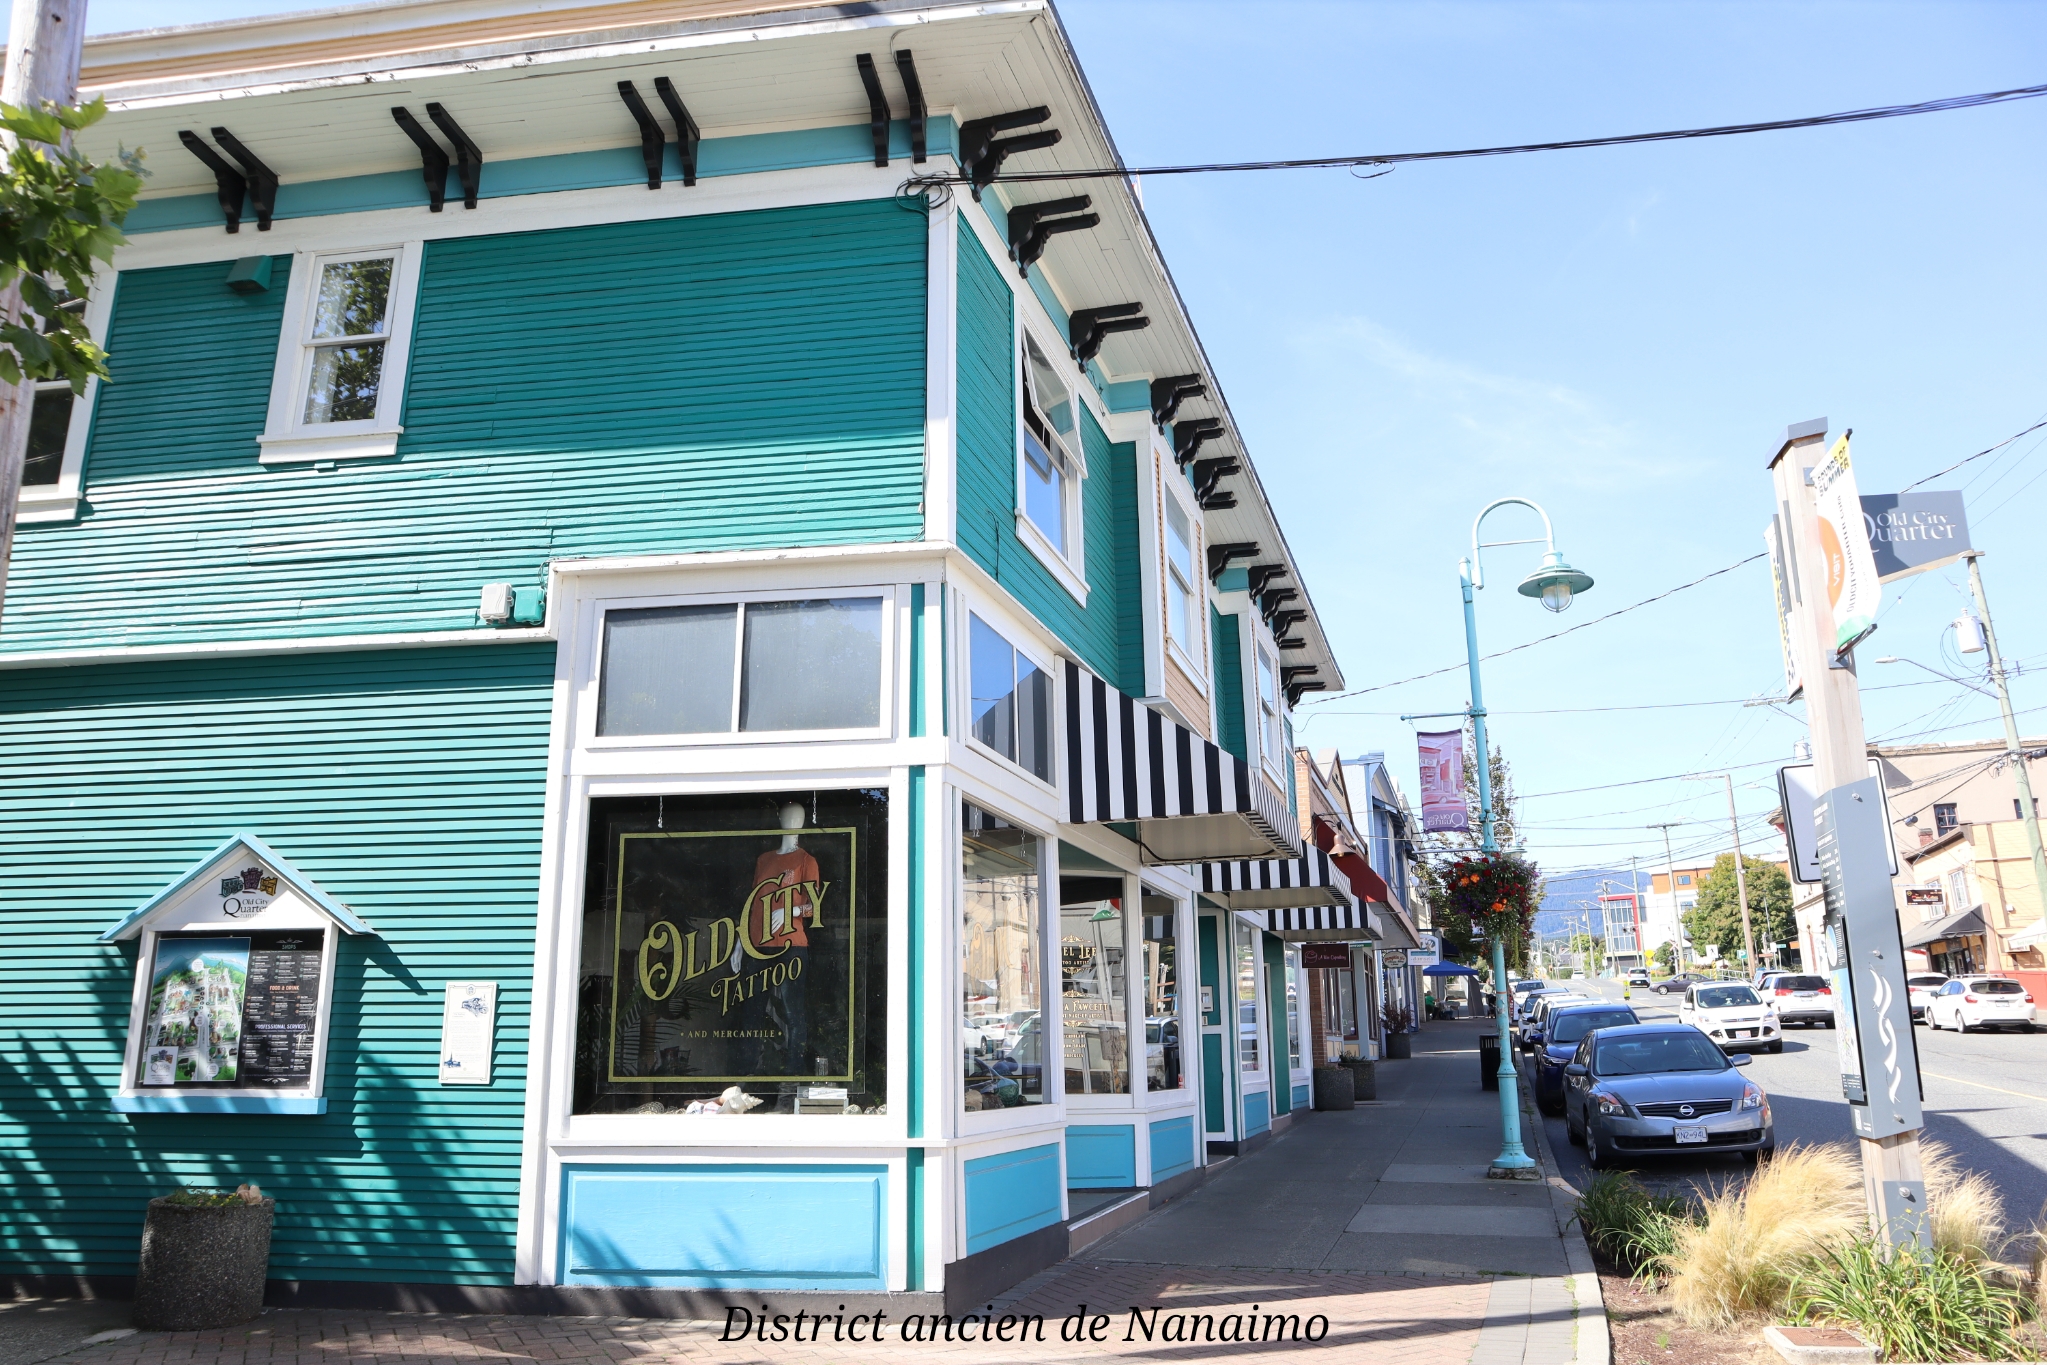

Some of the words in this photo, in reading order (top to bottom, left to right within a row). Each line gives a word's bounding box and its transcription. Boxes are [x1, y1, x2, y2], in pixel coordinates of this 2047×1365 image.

[1817, 455, 1839, 484] SOUNDS
[1838, 446, 1846, 460] OF
[1818, 456, 1850, 497] SUMMER
[1877, 512, 1908, 526] Old
[1912, 511, 1948, 525] City
[1832, 553, 1841, 587] VISIT
[223, 897, 268, 918] Quarter
[1072, 1000, 1108, 1013] FAWCETT
[687, 1030, 708, 1038] AND
[712, 1029, 776, 1038] MERCANTILE
